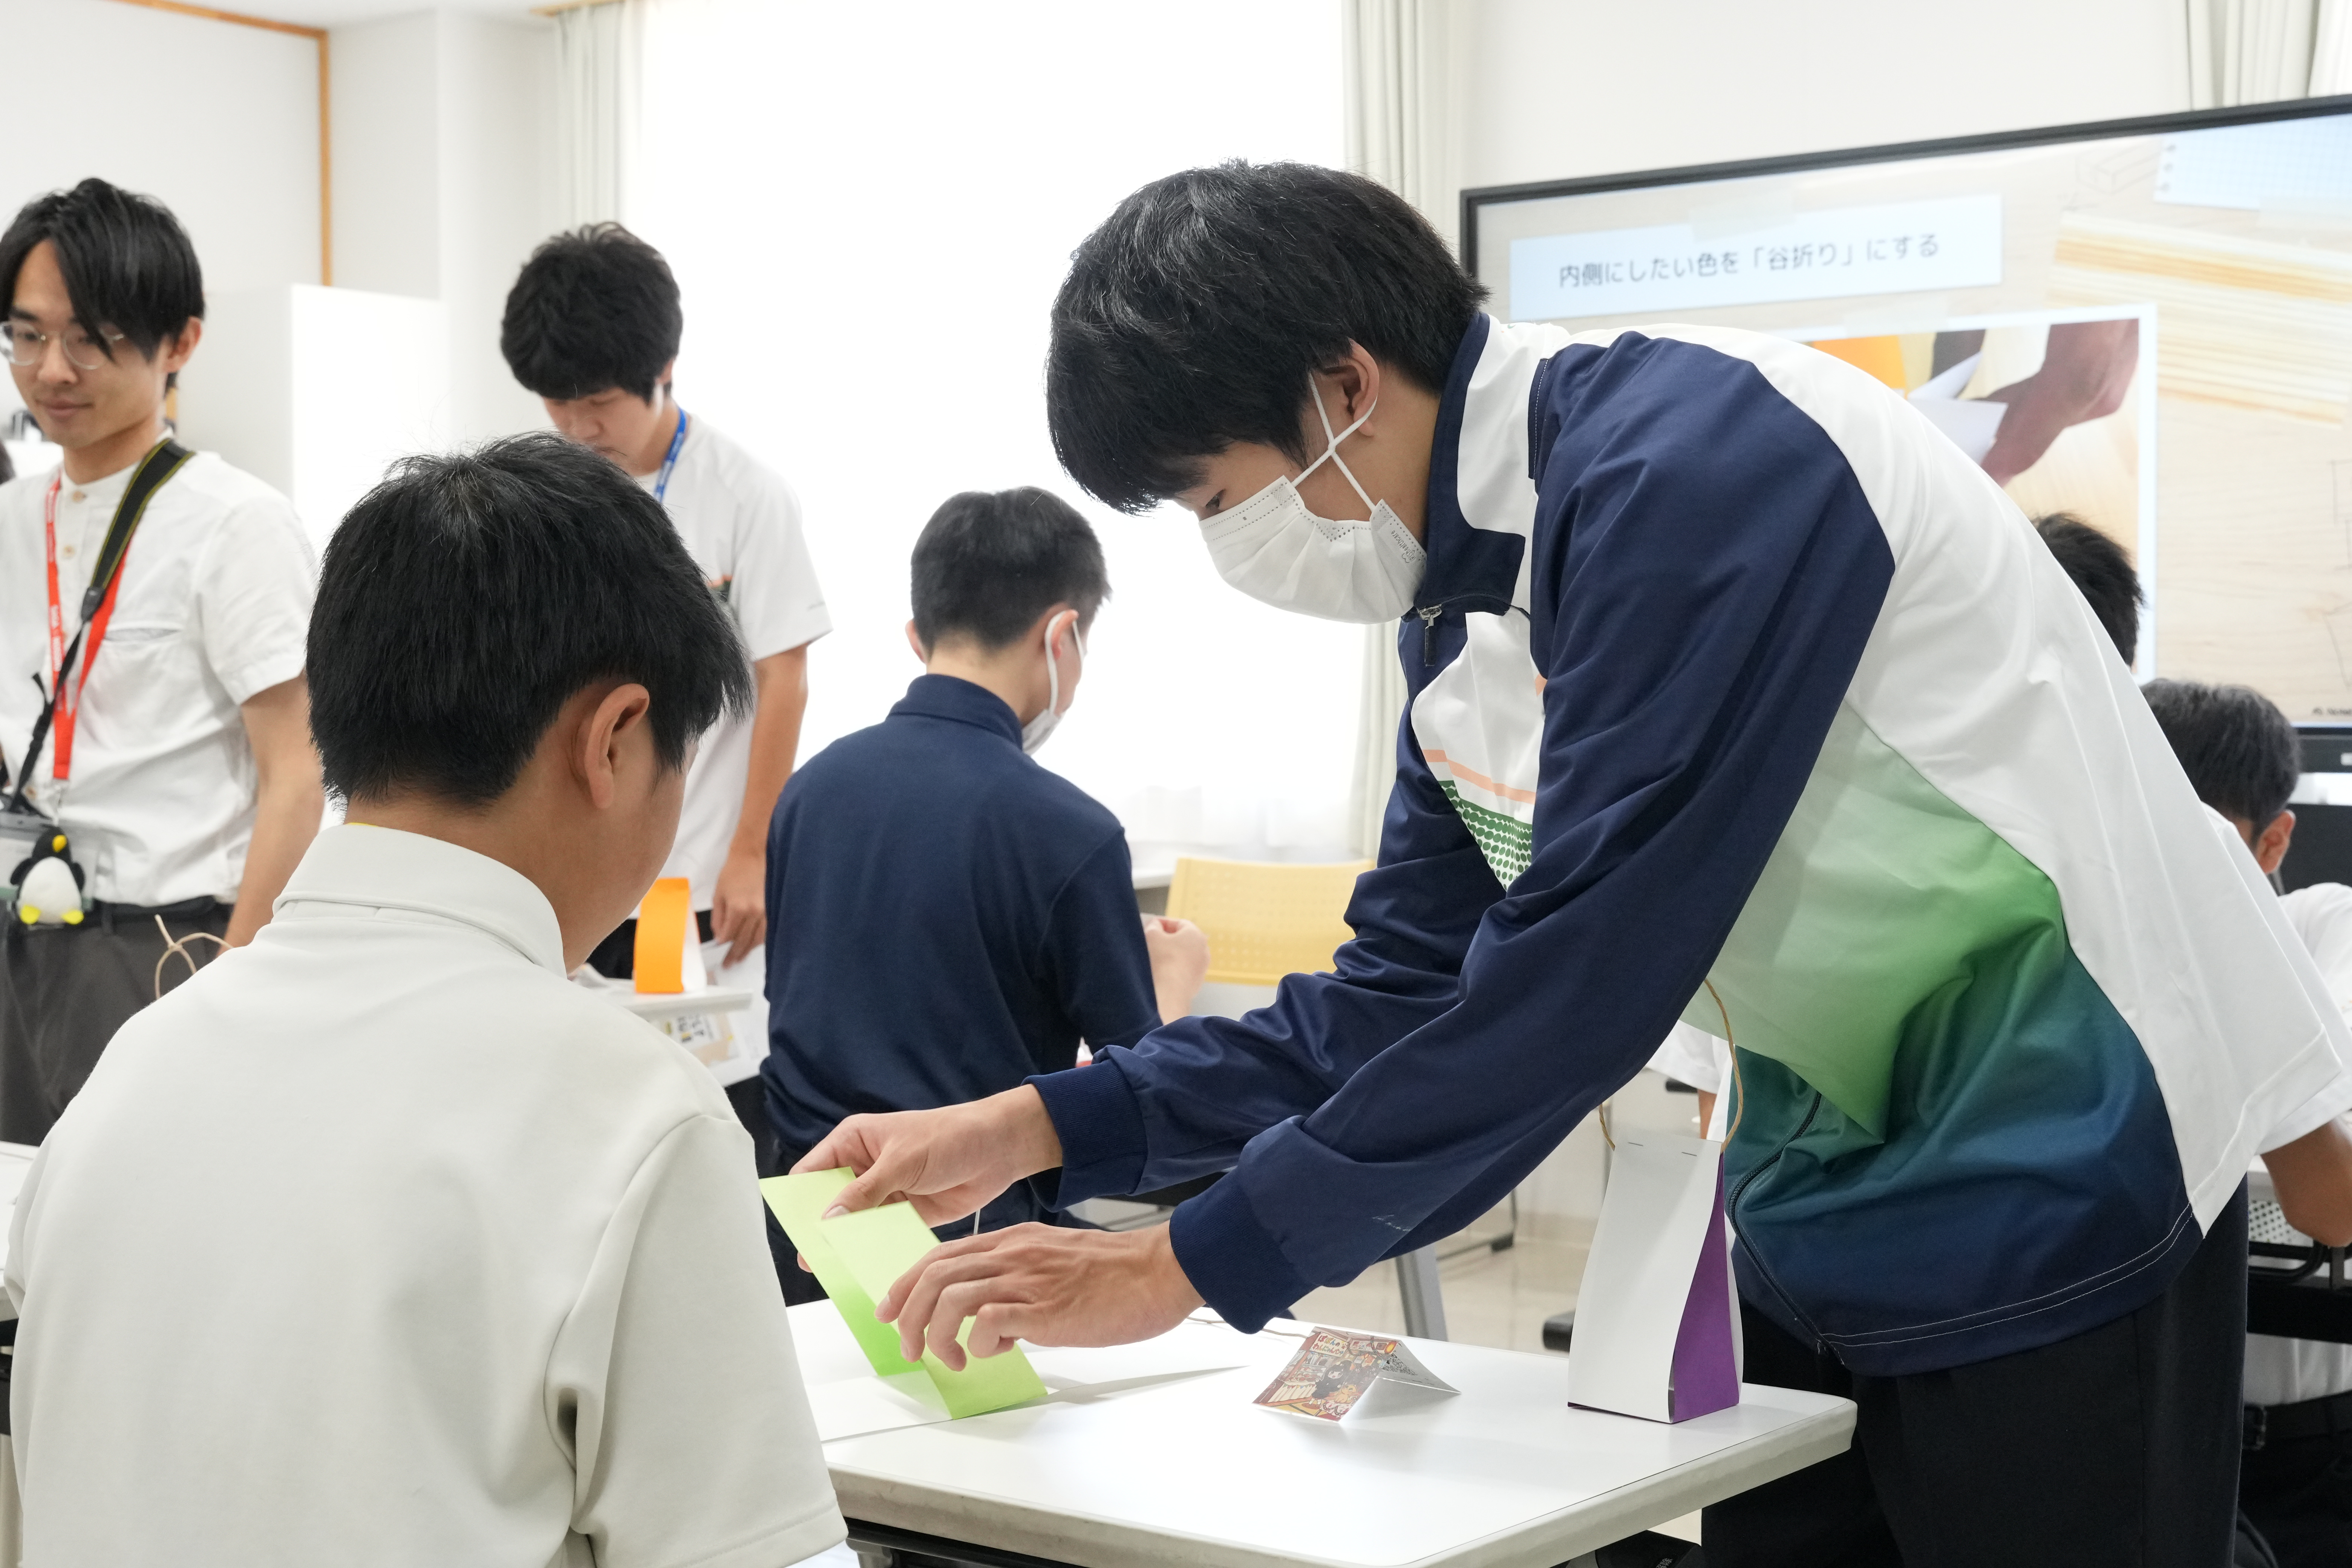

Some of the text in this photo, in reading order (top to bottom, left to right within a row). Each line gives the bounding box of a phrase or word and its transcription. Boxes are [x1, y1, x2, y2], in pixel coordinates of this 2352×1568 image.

[1558, 234, 1939, 288] 内側にしたい色を「谷折り」にする
